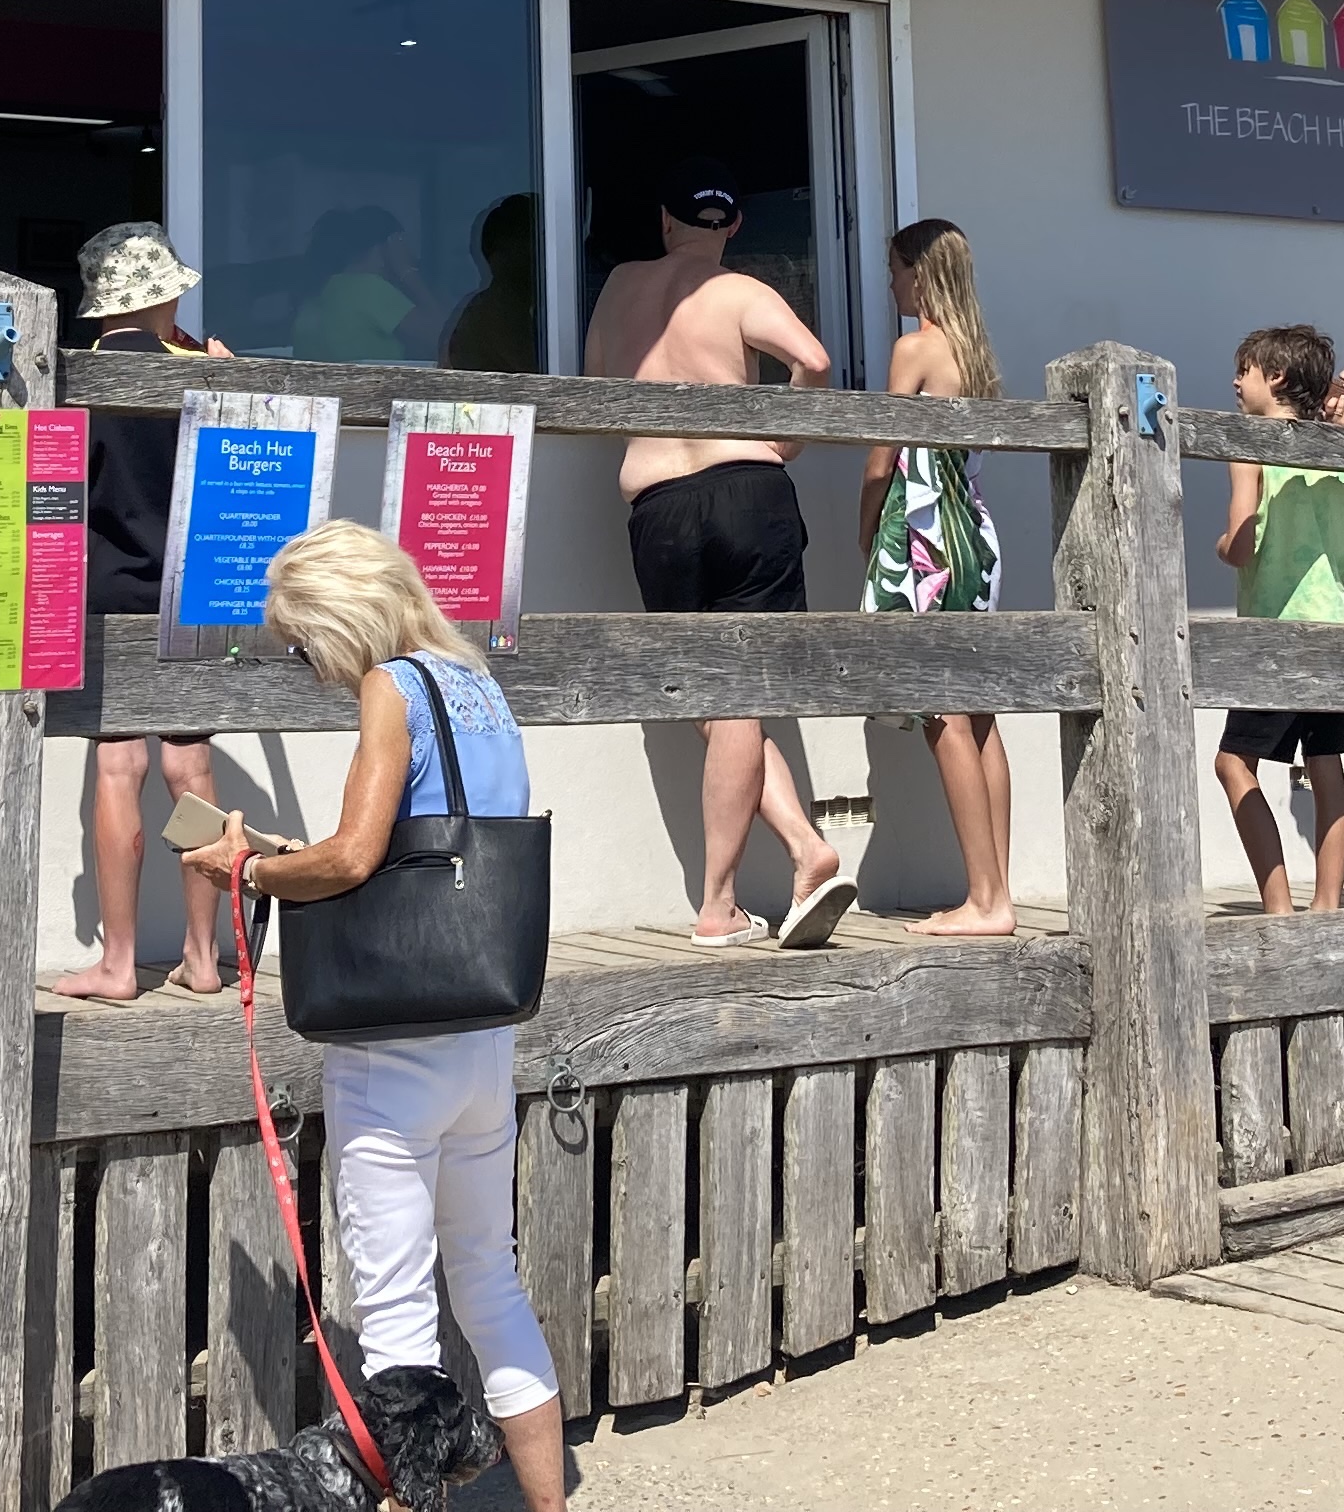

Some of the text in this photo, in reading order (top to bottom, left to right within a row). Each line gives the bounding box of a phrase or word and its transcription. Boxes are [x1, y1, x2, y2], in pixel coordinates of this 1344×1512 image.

[1180, 102, 1232, 137] THE
[1236, 106, 1321, 146] BEACH
[221, 439, 293, 457] Beach Hut
[427, 442, 493, 458] Beach Hut
[229, 455, 282, 476] Burgers
[439, 458, 477, 473] Pizzas
